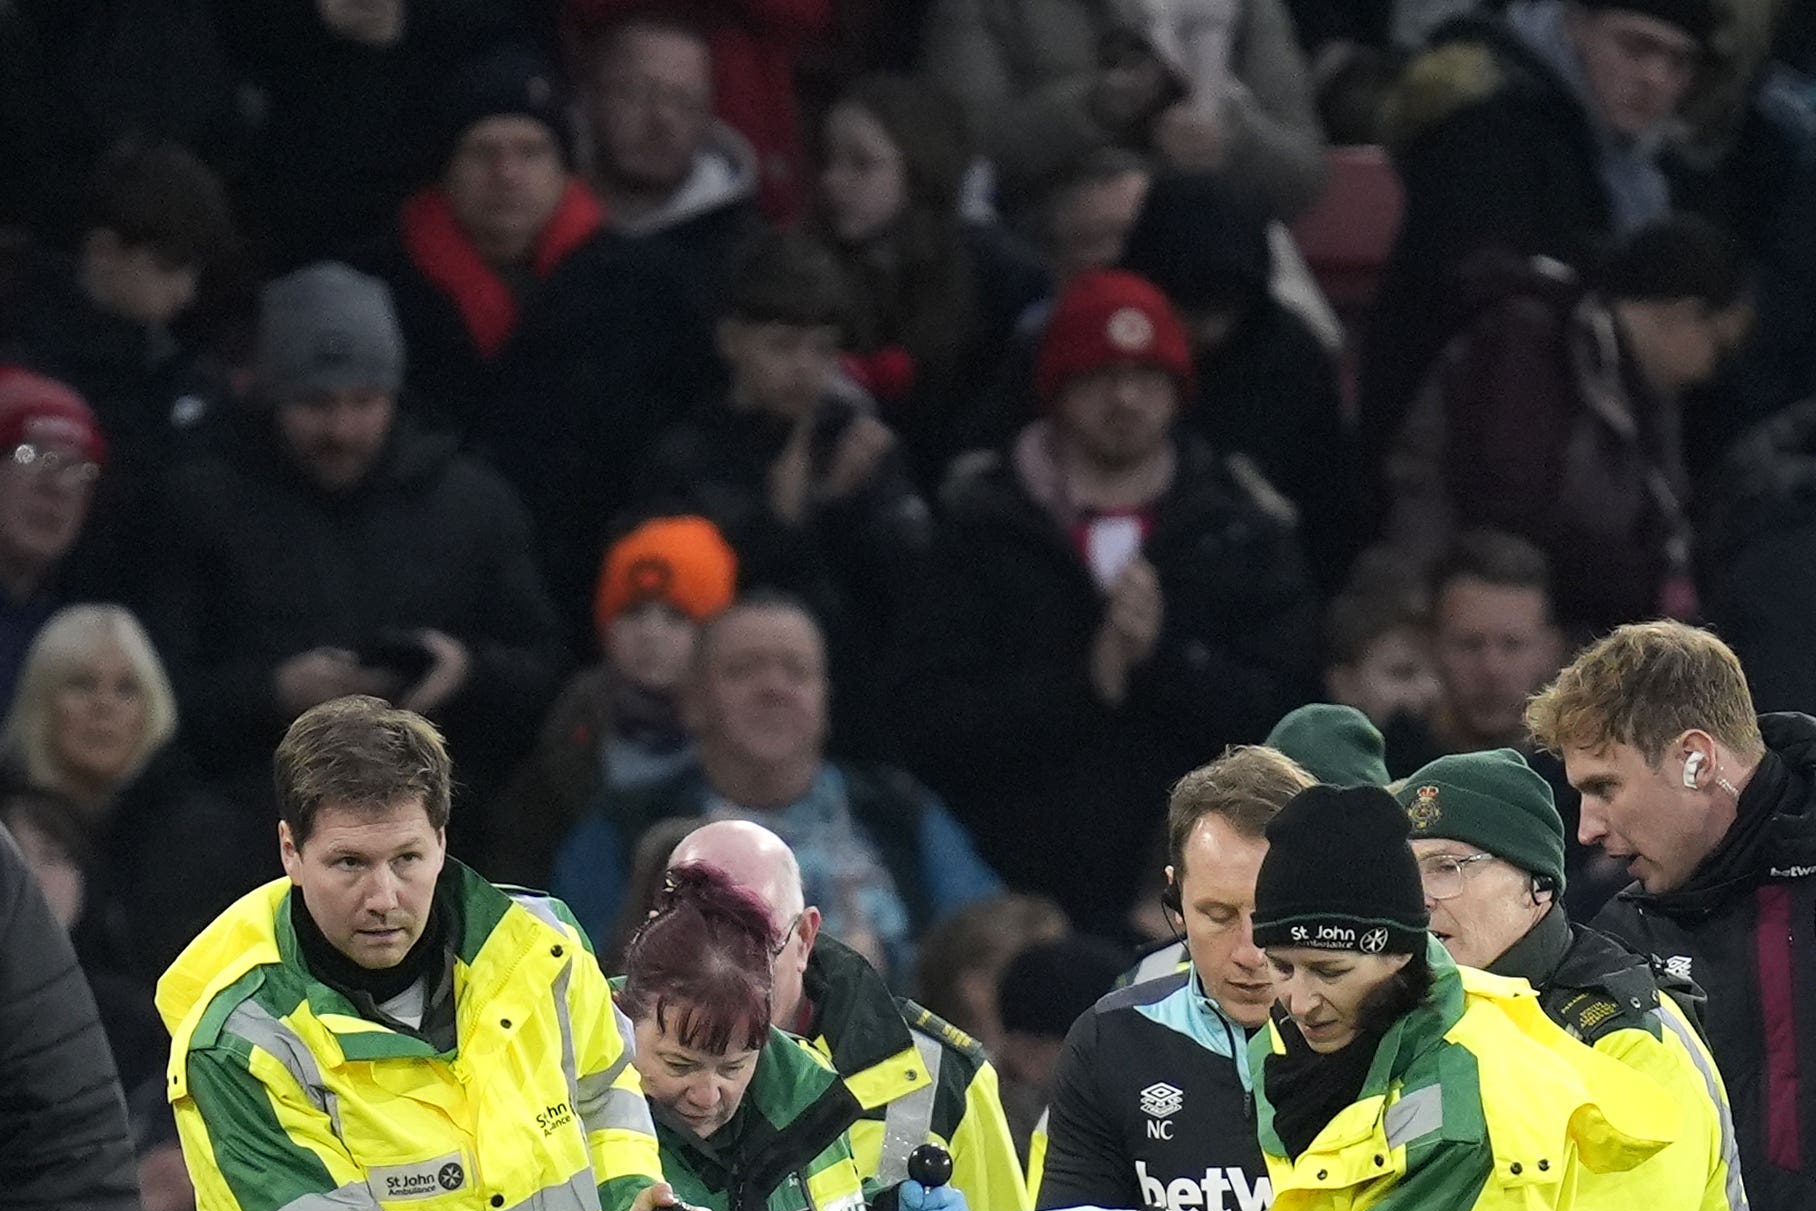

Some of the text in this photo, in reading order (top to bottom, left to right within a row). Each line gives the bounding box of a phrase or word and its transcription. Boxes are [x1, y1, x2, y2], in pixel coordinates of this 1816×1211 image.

[1291, 925, 1356, 941] St John
[1147, 1119, 1175, 1141] NC
[386, 1173, 436, 1189] St John
[387, 1184, 436, 1197] Ambulance
